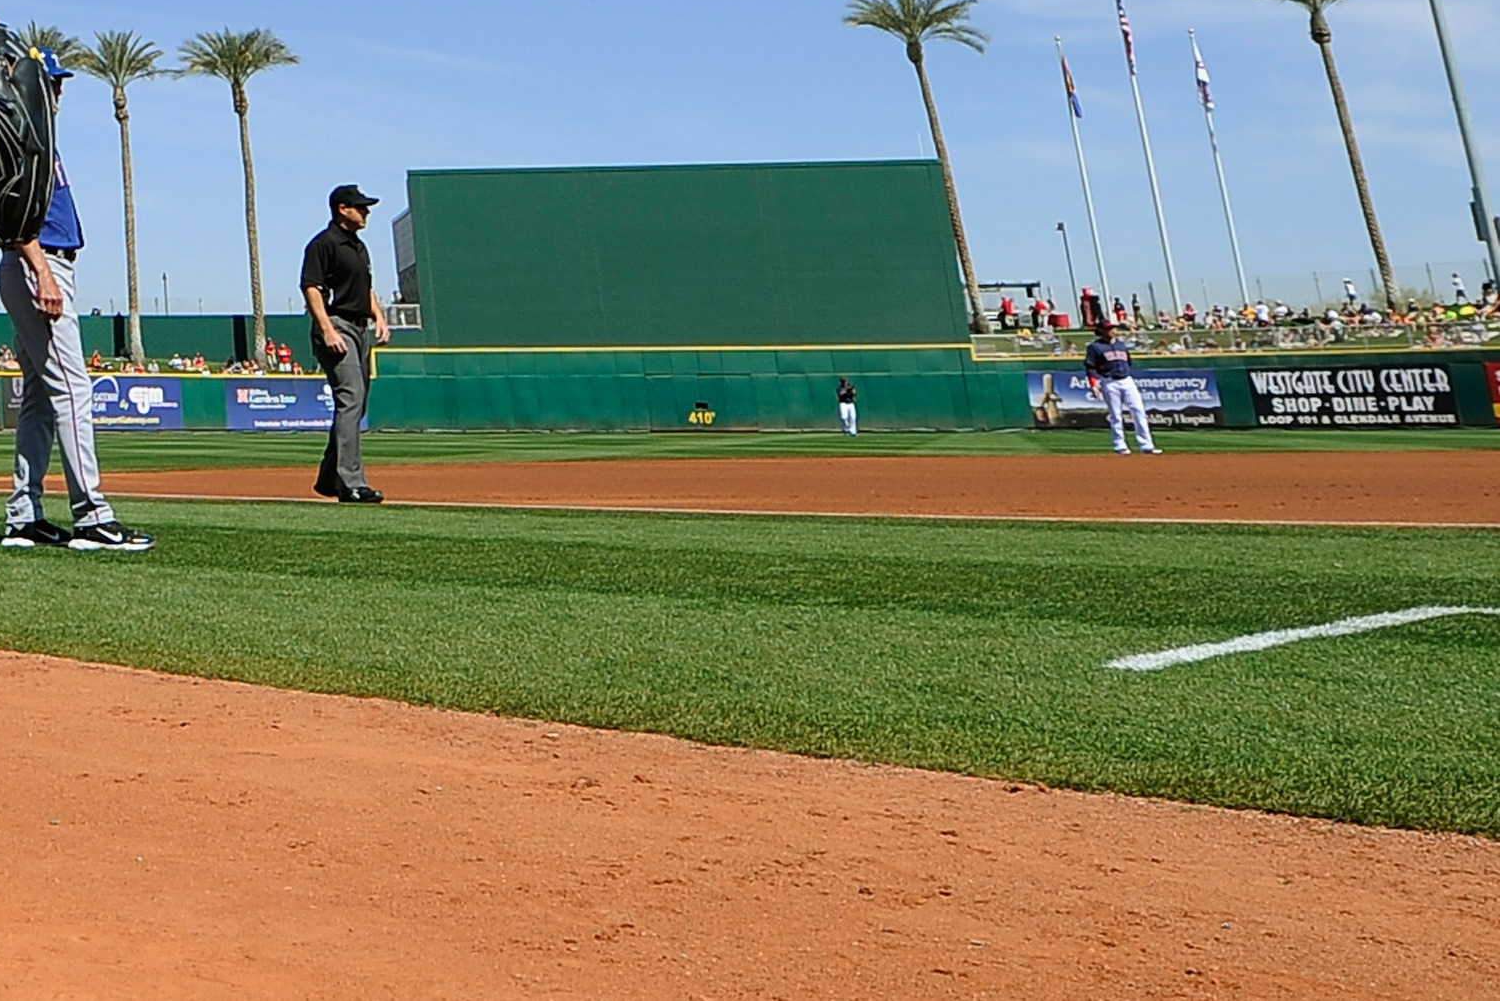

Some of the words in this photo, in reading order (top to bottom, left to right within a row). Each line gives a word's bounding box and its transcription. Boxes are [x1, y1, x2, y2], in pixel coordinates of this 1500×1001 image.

[1250, 371, 1336, 395] WESTGATE
[1336, 369, 1376, 394] CITY
[1379, 367, 1451, 393] CENTER
[1271, 397, 1323, 413] SHOP
[1332, 396, 1379, 412] DINE
[1388, 395, 1436, 411] PLAY
[1173, 413, 1215, 426] Hospital
[1259, 414, 1295, 425] LOOP
[1297, 414, 1319, 425] 101
[1334, 413, 1401, 424] GLENDALE
[1404, 413, 1457, 423] AVENUE
